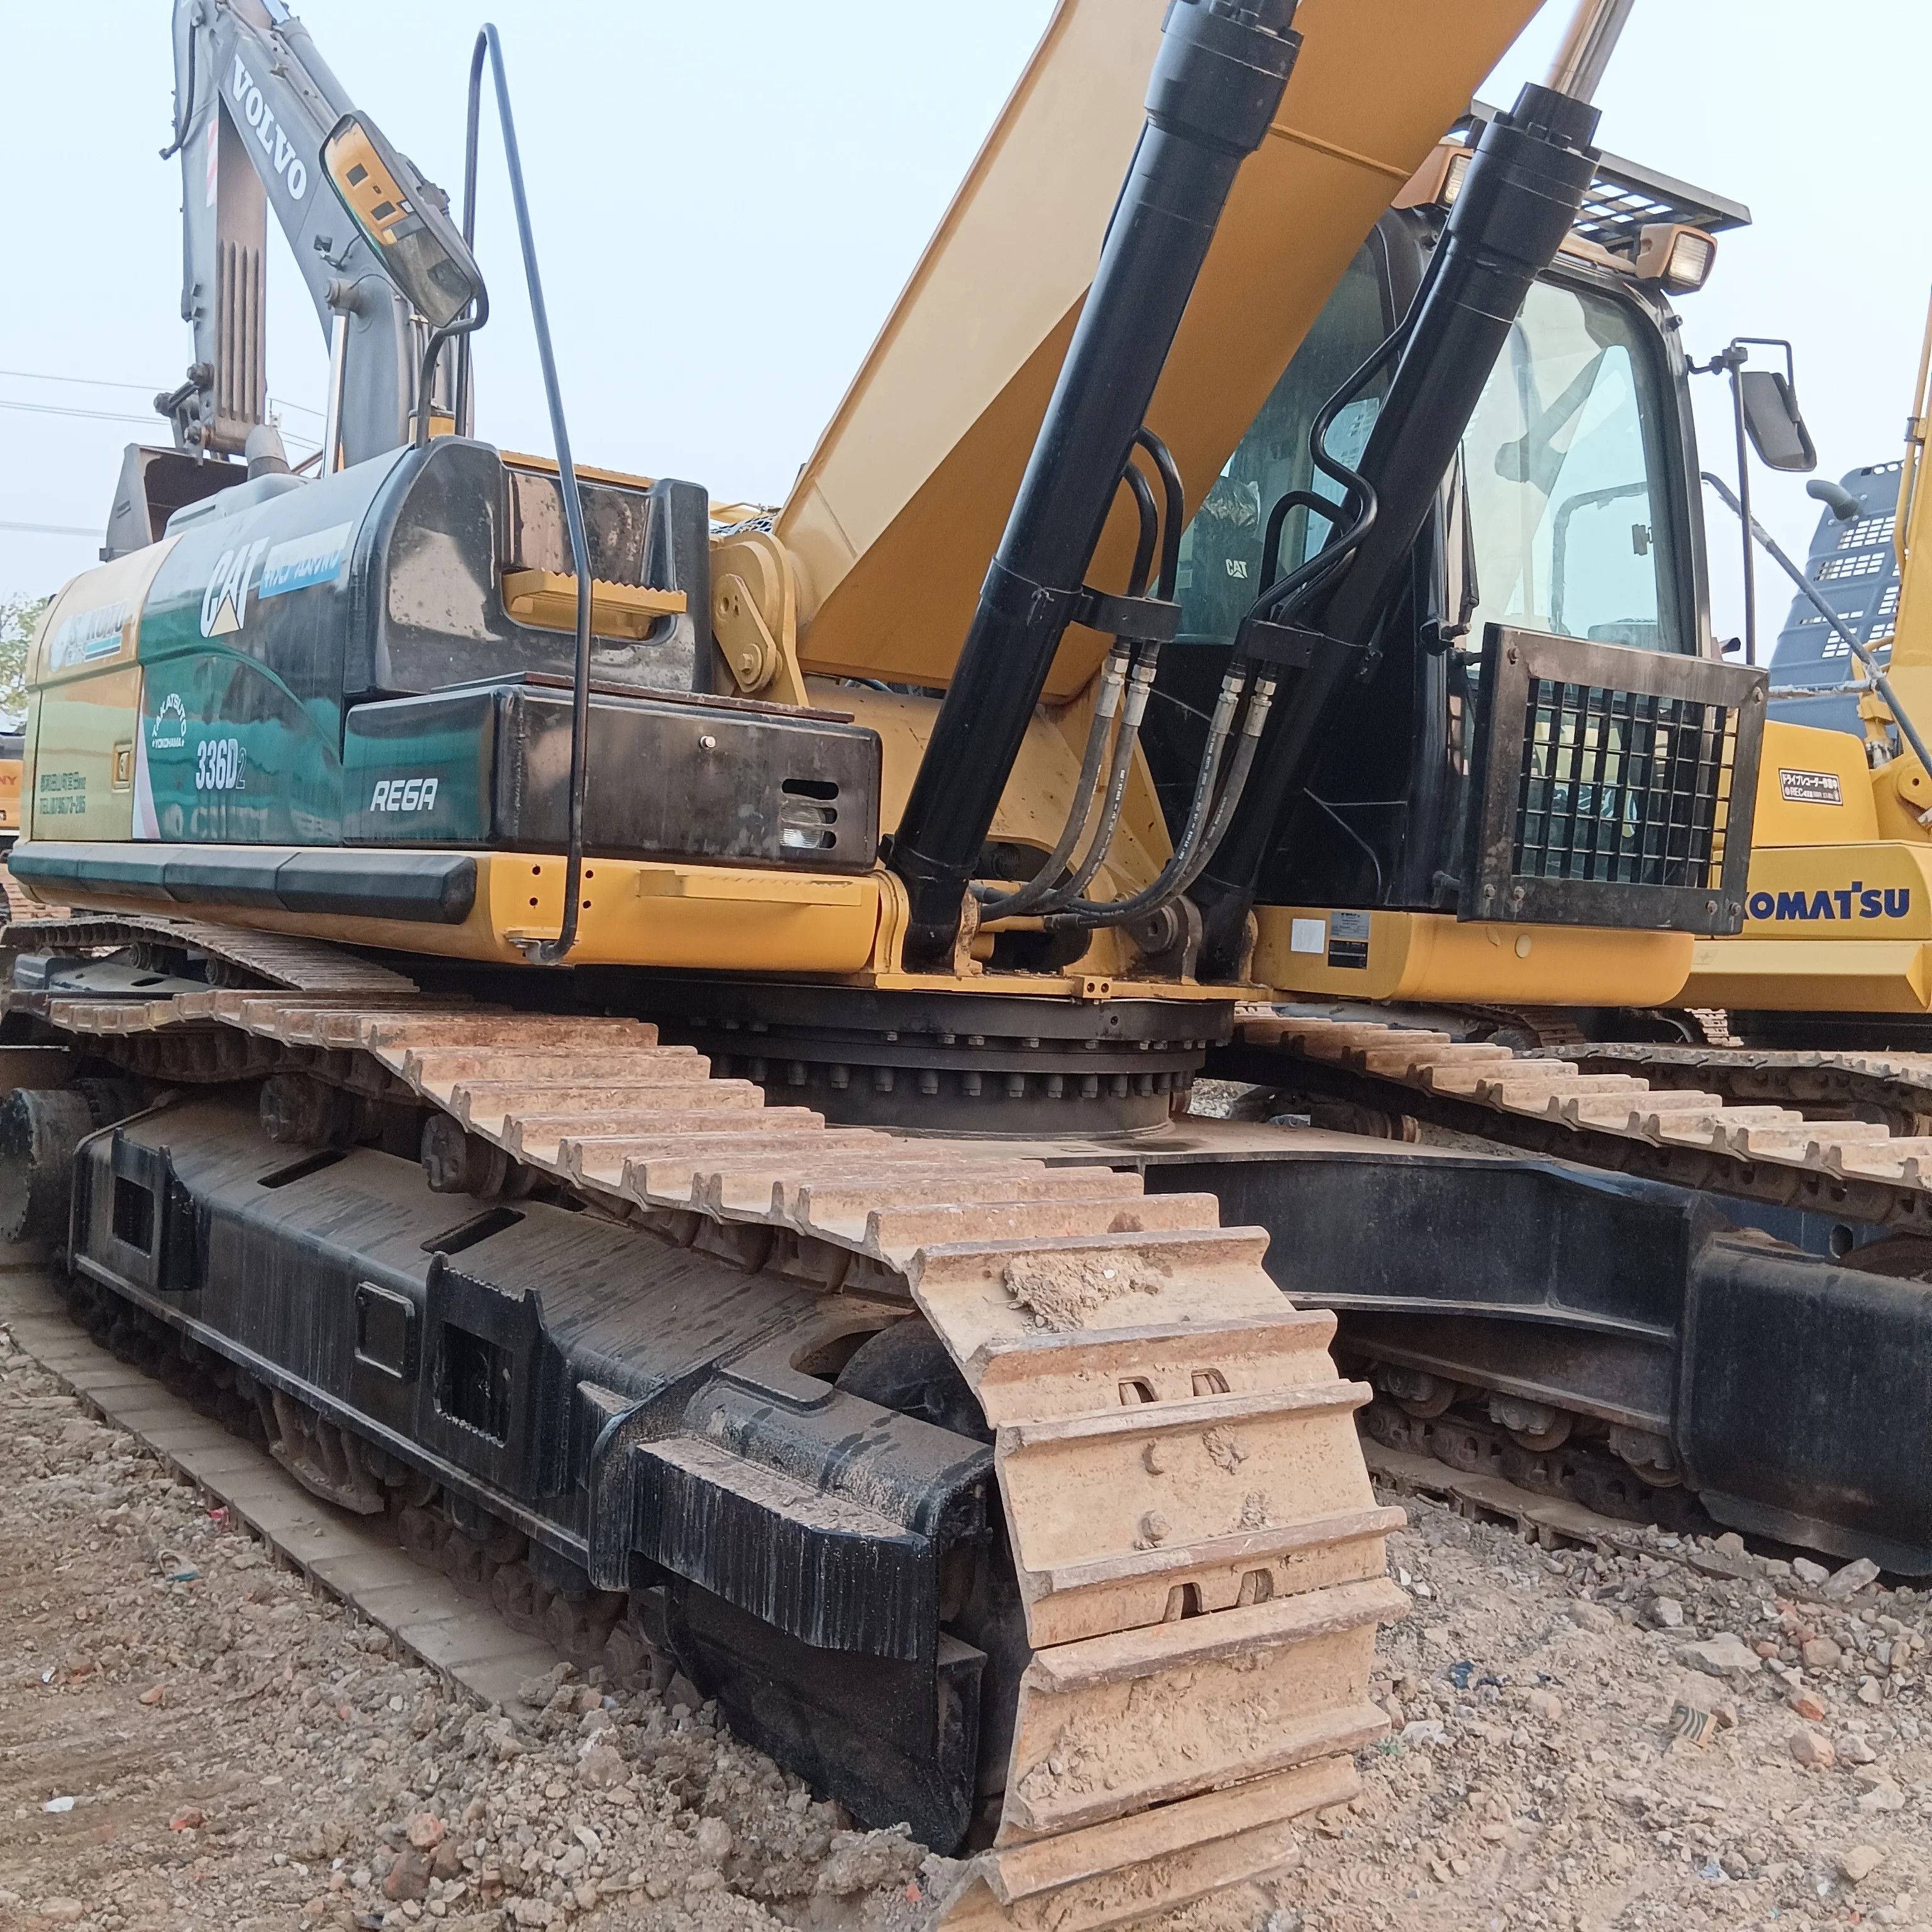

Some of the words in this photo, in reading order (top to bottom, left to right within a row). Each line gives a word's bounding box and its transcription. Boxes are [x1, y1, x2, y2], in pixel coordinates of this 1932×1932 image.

[233, 53, 307, 200] VOLVO
[200, 536, 270, 638] CAT
[1225, 558, 1248, 579] CAT
